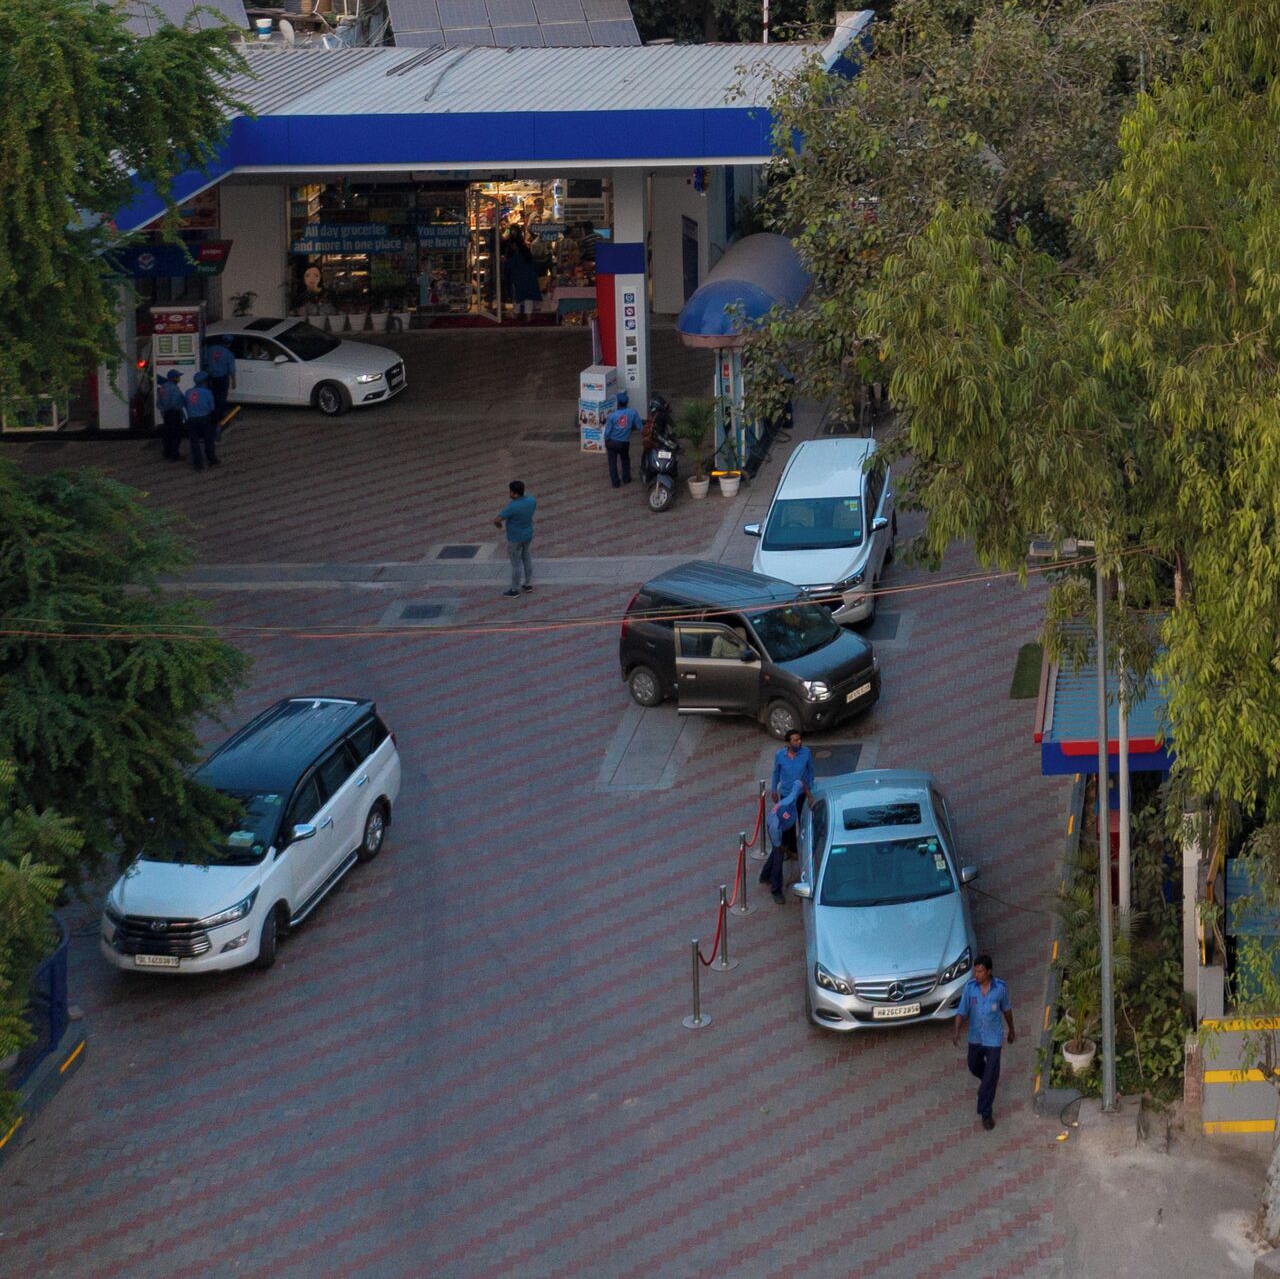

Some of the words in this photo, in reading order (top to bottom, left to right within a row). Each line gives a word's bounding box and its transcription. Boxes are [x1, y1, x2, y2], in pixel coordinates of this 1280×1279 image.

[305, 225, 318, 237] All
[320, 225, 339, 238] day
[340, 223, 387, 238] groceries
[417, 225, 436, 236] You
[437, 225, 458, 236] need
[293, 240, 313, 252] and
[315, 239, 341, 252] more
[354, 239, 374, 250] one
[375, 237, 401, 252] place
[420, 238, 434, 248] we
[435, 237, 457, 248] have
